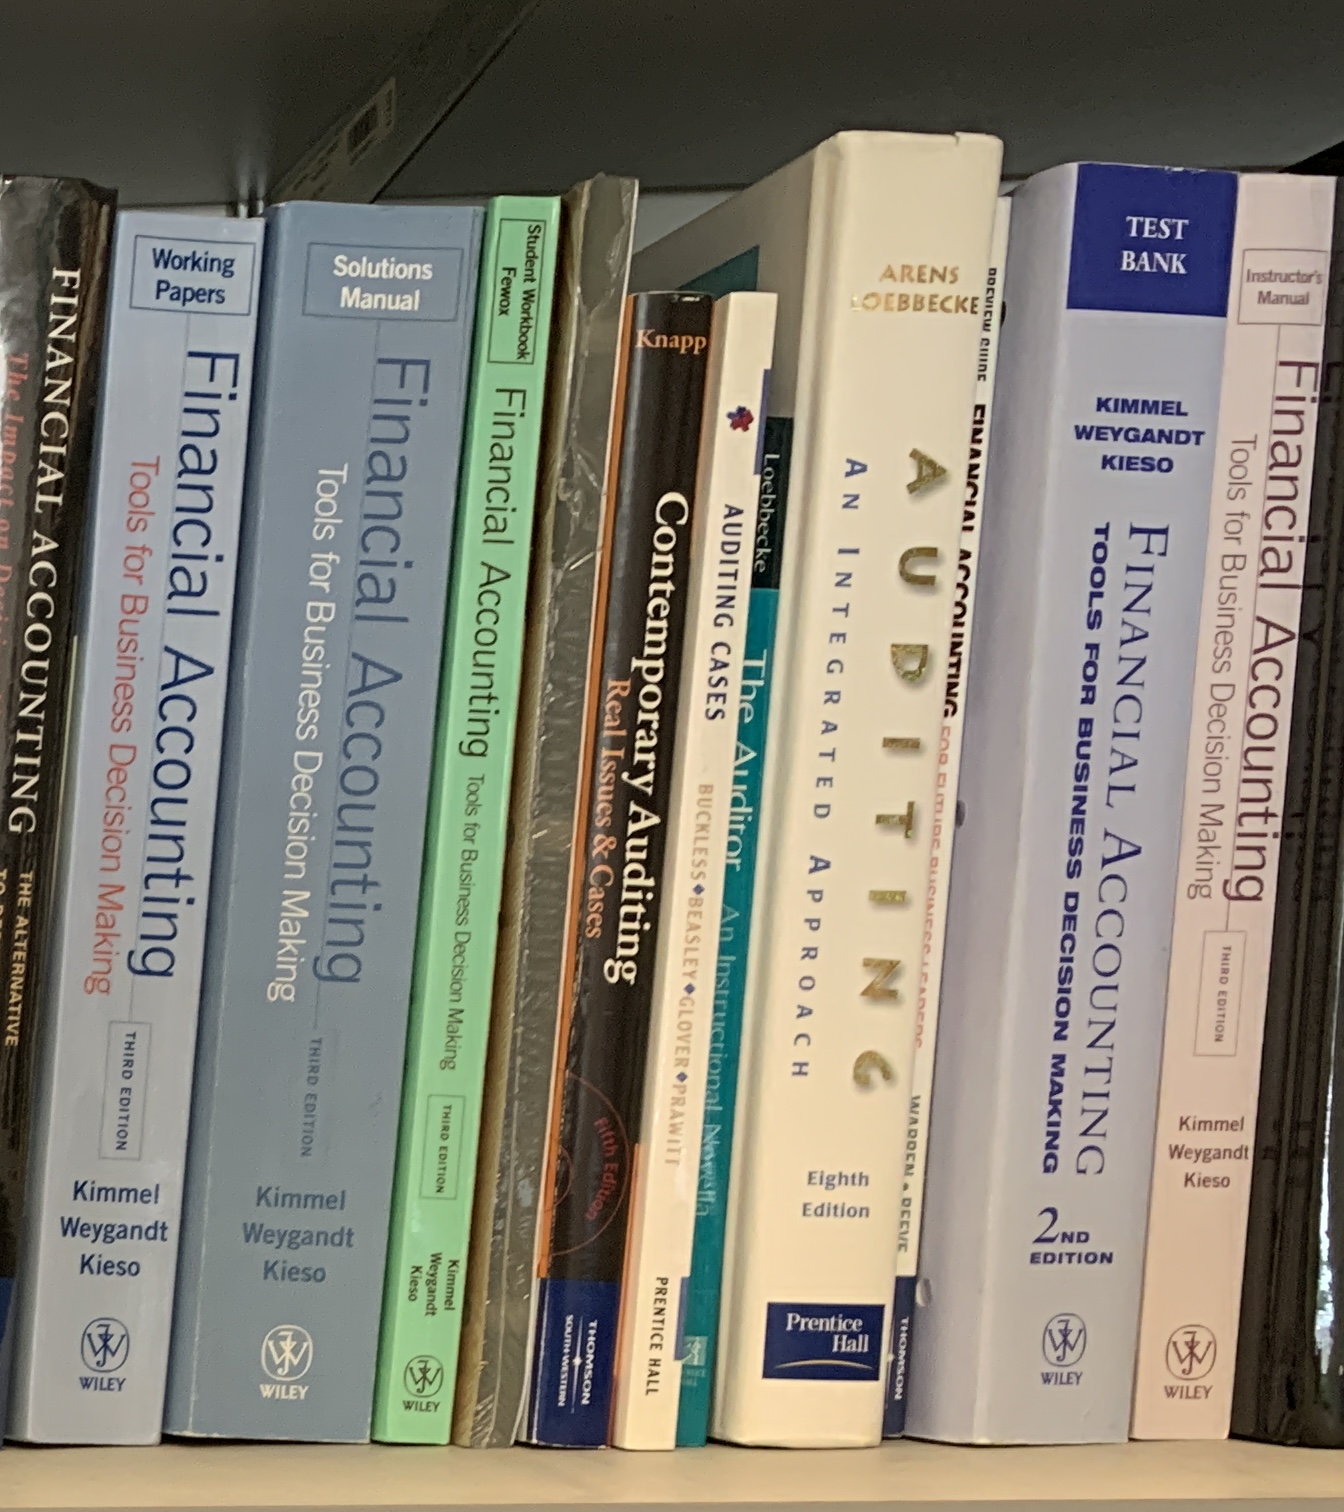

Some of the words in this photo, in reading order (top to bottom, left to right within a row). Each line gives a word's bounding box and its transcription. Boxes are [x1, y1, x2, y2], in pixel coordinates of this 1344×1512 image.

[1125, 217, 1189, 241] TEST
[152, 247, 235, 278] Working
[333, 255, 433, 280] Solutions
[524, 223, 542, 289] Student
[1121, 250, 1188, 275] BANK
[879, 264, 960, 284] ARENS
[156, 280, 226, 305] Papers
[340, 287, 420, 311] Manual
[514, 291, 538, 362] Workbook
[636, 329, 707, 356] Knapp
[1096, 397, 1188, 417] KIMMEL
[1074, 425, 1205, 446] WEYGANDT
[480, 385, 525, 546] Financial
[1101, 454, 1174, 474] KIESO
[166, 349, 241, 617] Financial
[620, 490, 690, 793] Contemporary
[467, 562, 512, 759] Accounting
[1105, 521, 1170, 808] FINANCIAL
[126, 645, 215, 978] Accounting
[602, 802, 662, 986] Auditing
[1075, 828, 1143, 1176] ACCOUNTING
[807, 1169, 869, 1189] Eighth
[72, 1180, 160, 1205] Kimmel
[801, 1201, 869, 1219] Edition
[59, 1217, 169, 1243] Weygandt
[79, 1254, 141, 1277] Kieso
[786, 1313, 863, 1332] Prentice
[832, 1332, 869, 1353] Hall
[79, 1377, 126, 1392] WILEY
